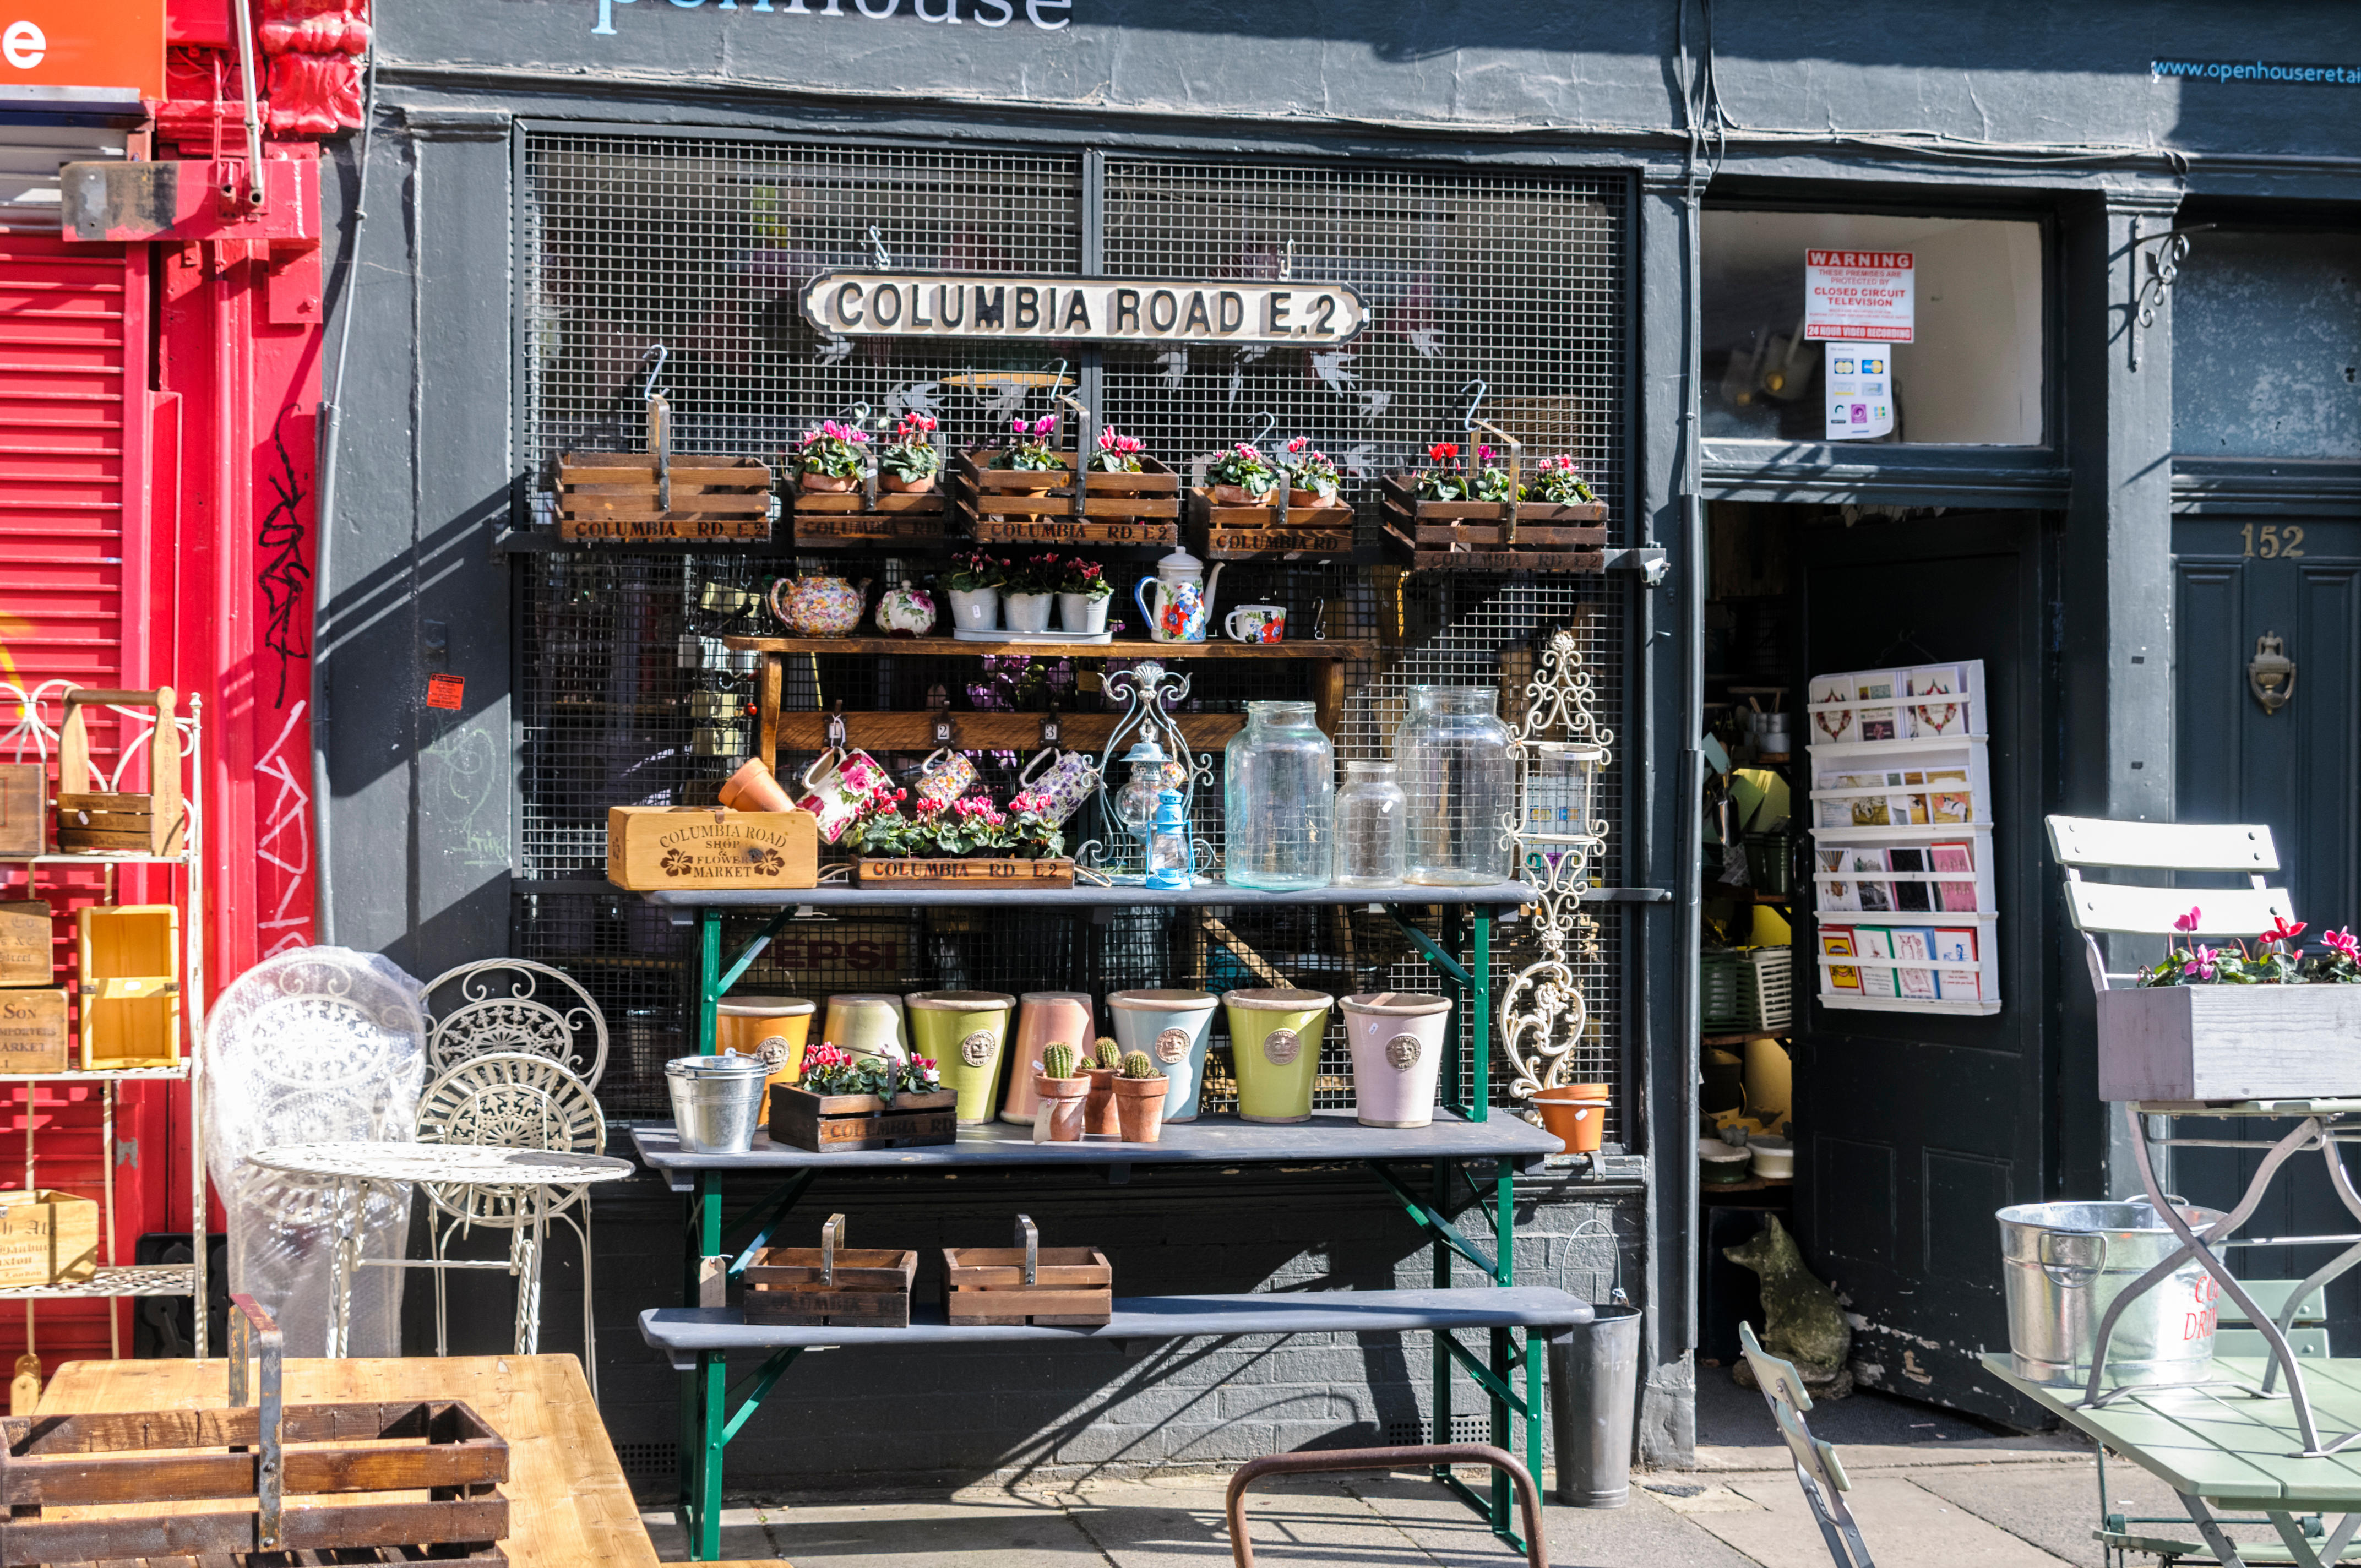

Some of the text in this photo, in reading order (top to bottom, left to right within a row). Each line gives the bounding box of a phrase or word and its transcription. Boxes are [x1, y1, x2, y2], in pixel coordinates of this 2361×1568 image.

[1810, 252, 1910, 268] WARNING
[1814, 287, 1906, 297] CLOSED CIRCUIT
[836, 282, 1335, 334] COLUMBIA ROAD E.2
[1828, 297, 1893, 306] TELEVISION
[1808, 326, 1910, 339] 24 HOUR VIDEO RECORDING
[575, 521, 678, 537] COLUMBIA
[803, 521, 899, 535] COLUMBIA
[991, 523, 1087, 539] COLUMBIA
[1216, 535, 1338, 551] COLUMBIA RD
[2240, 522, 2305, 559] 152
[939, 725, 948, 737] 2
[1046, 725, 1054, 738] 3
[660, 824, 787, 848] COLUMBIA ROAD
[705, 840, 740, 849] SHOP
[718, 848, 727, 857] &
[693, 867, 752, 878] MARKET
[873, 862, 969, 878] COLUMBIA
[741, 939, 897, 971] EPSI
